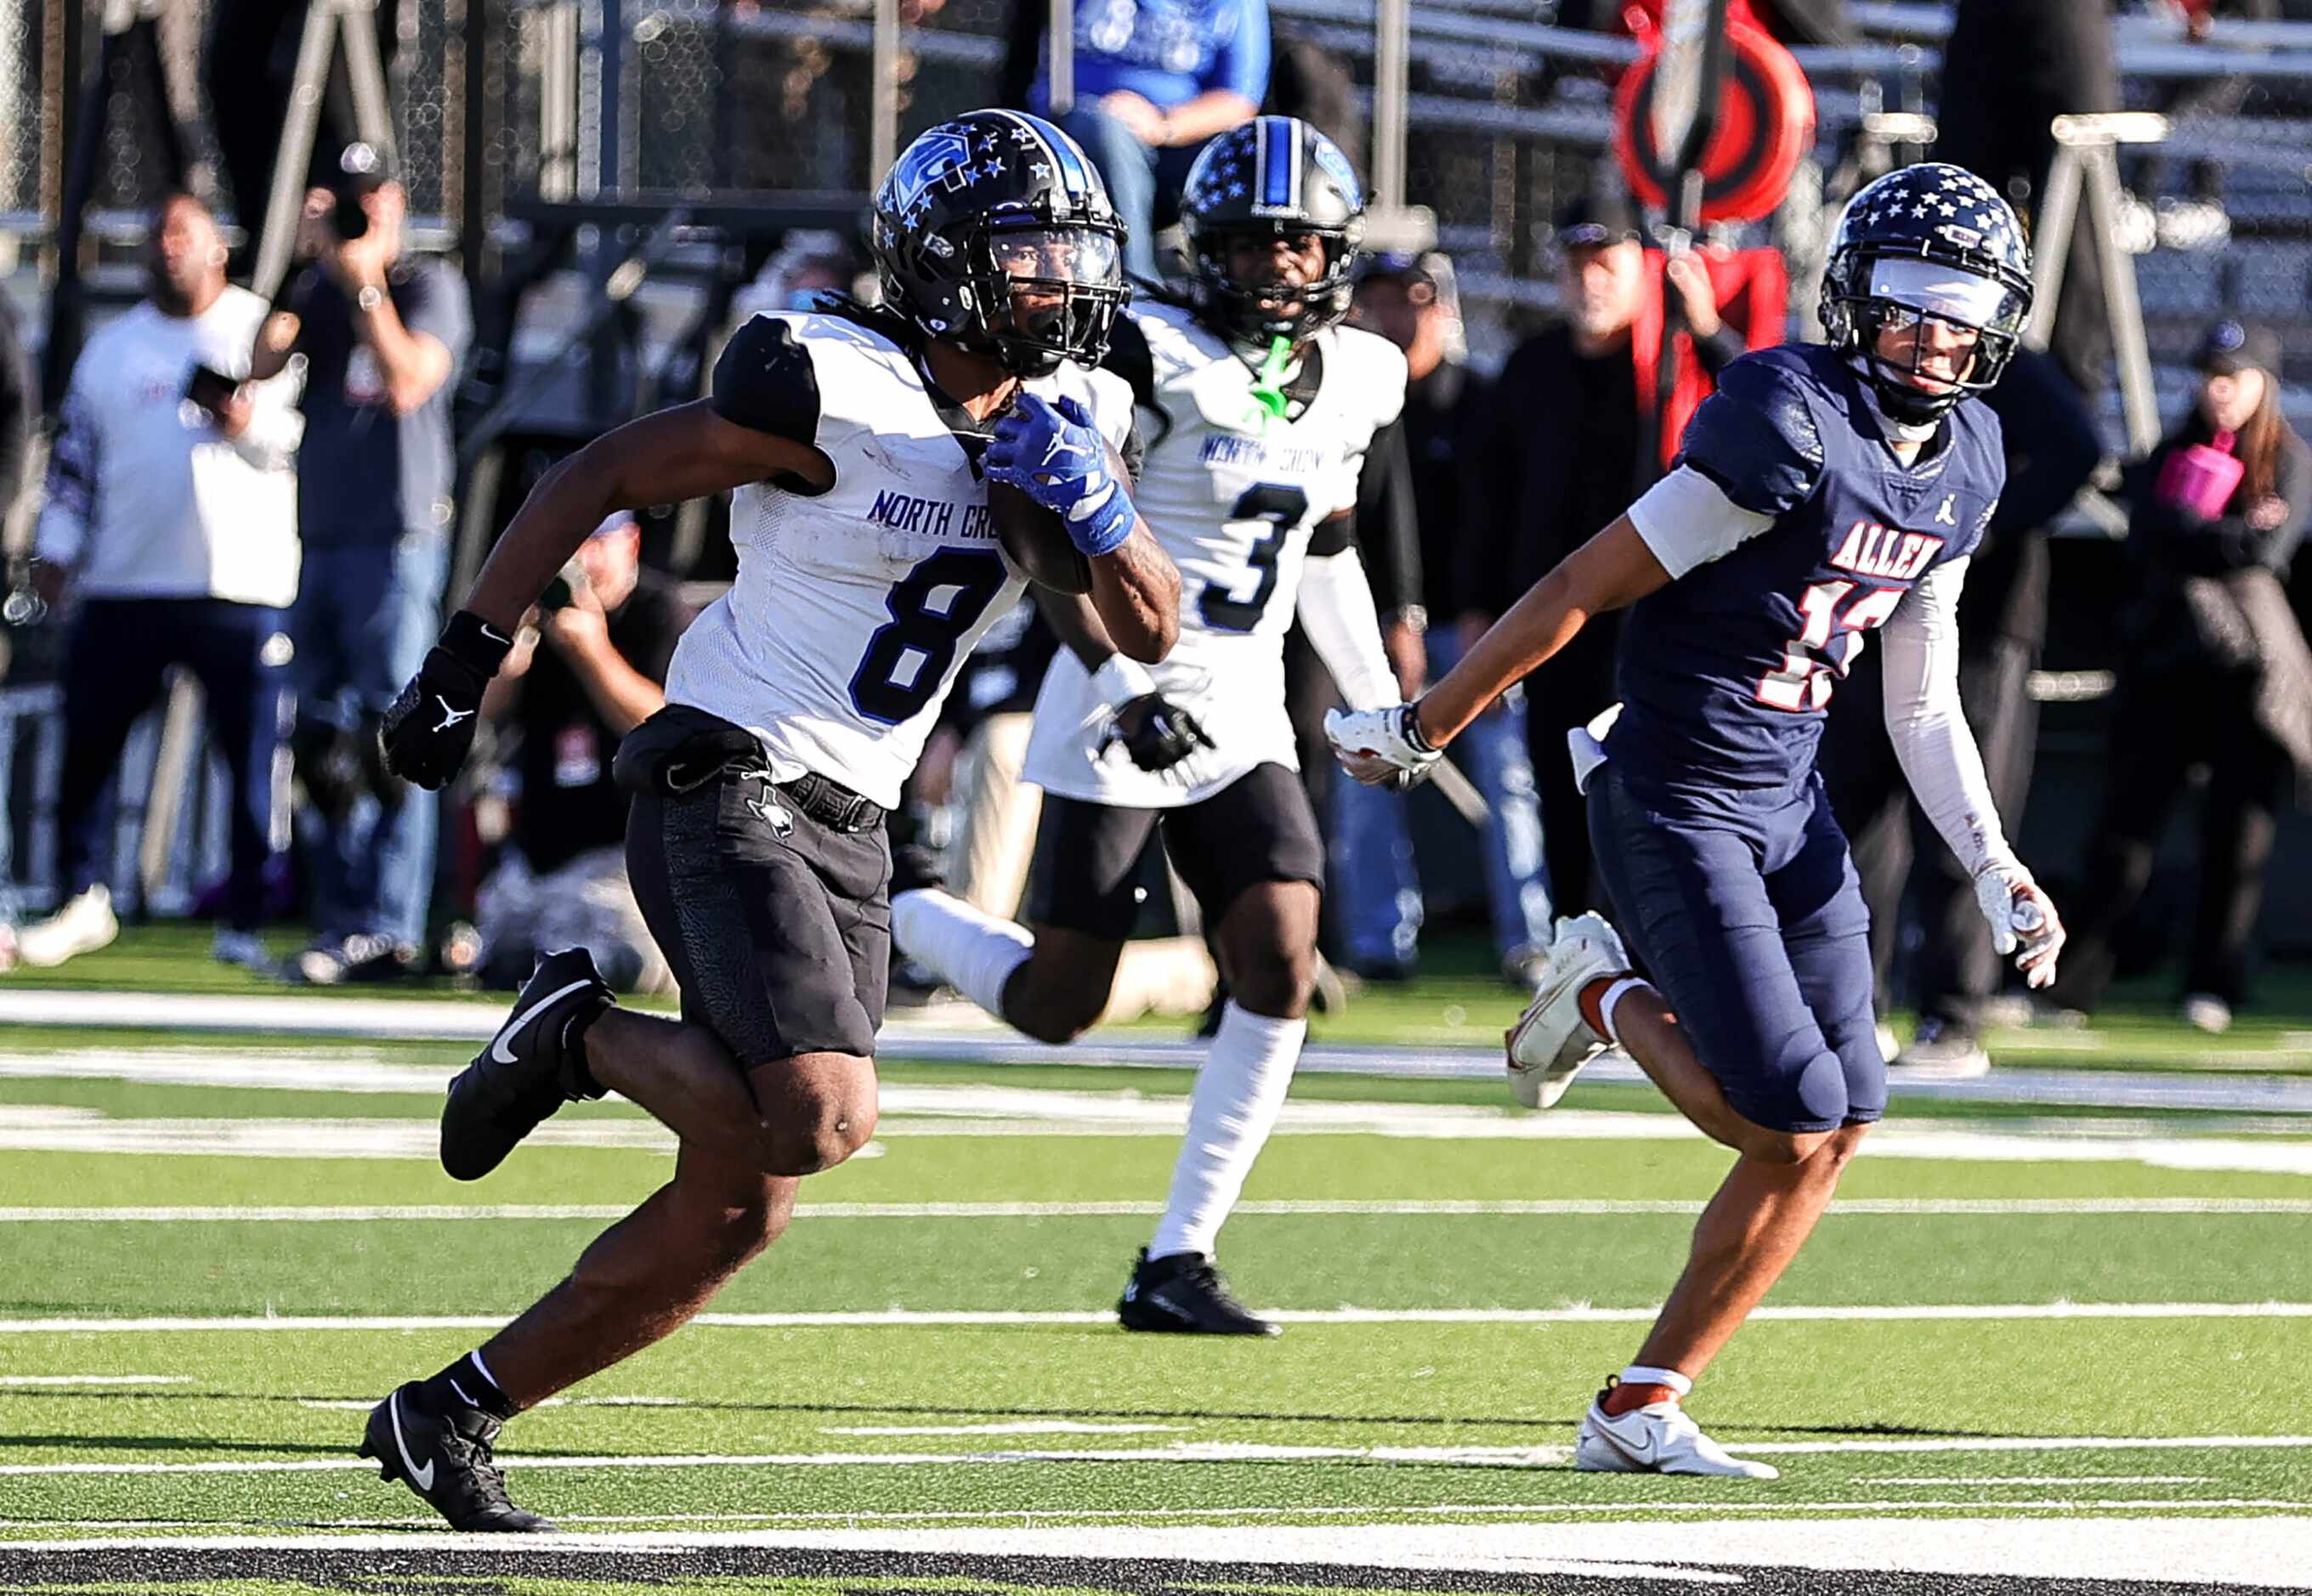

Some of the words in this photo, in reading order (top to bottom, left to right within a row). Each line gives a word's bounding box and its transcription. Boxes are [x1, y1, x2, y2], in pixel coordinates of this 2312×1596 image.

[867, 490, 954, 536] NORTH
[1197, 481, 1308, 632] 3
[1829, 519, 1946, 580] ALLEN
[847, 546, 1009, 726] 8
